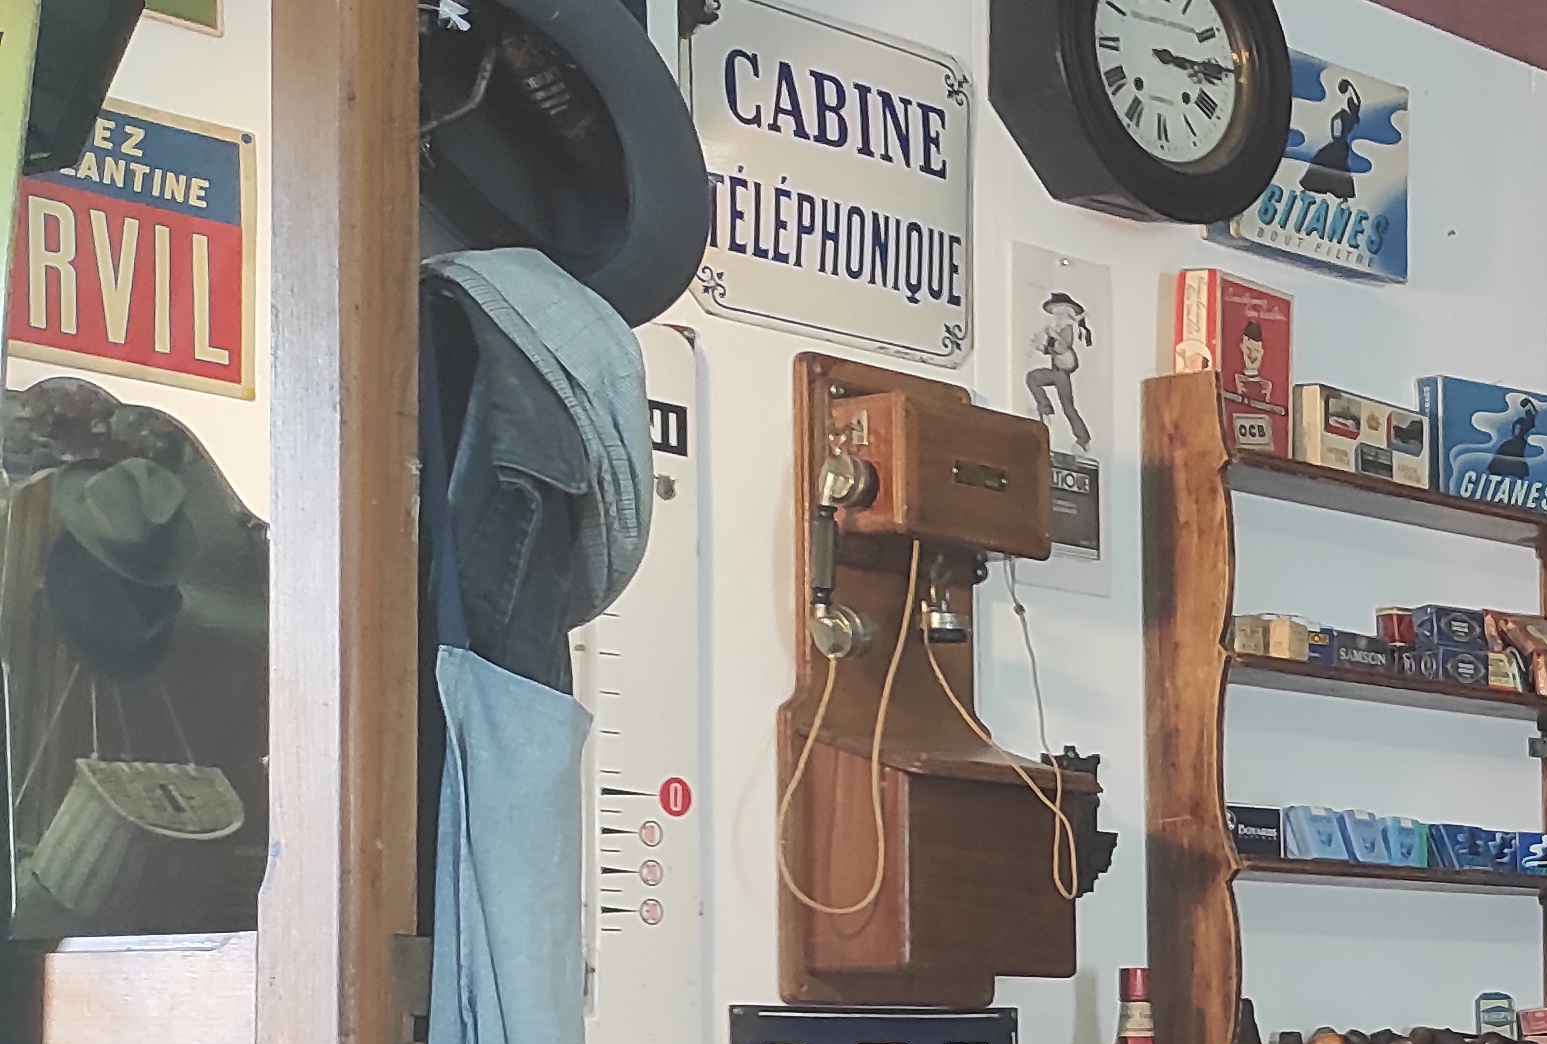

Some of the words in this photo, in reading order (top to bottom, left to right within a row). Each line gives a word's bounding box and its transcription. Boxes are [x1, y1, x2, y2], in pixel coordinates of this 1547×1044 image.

[723, 48, 949, 180] CABINE
[1257, 183, 1390, 255] GITANES
[1238, 422, 1266, 437] OCB
[1339, 646, 1387, 665] SAMSON
